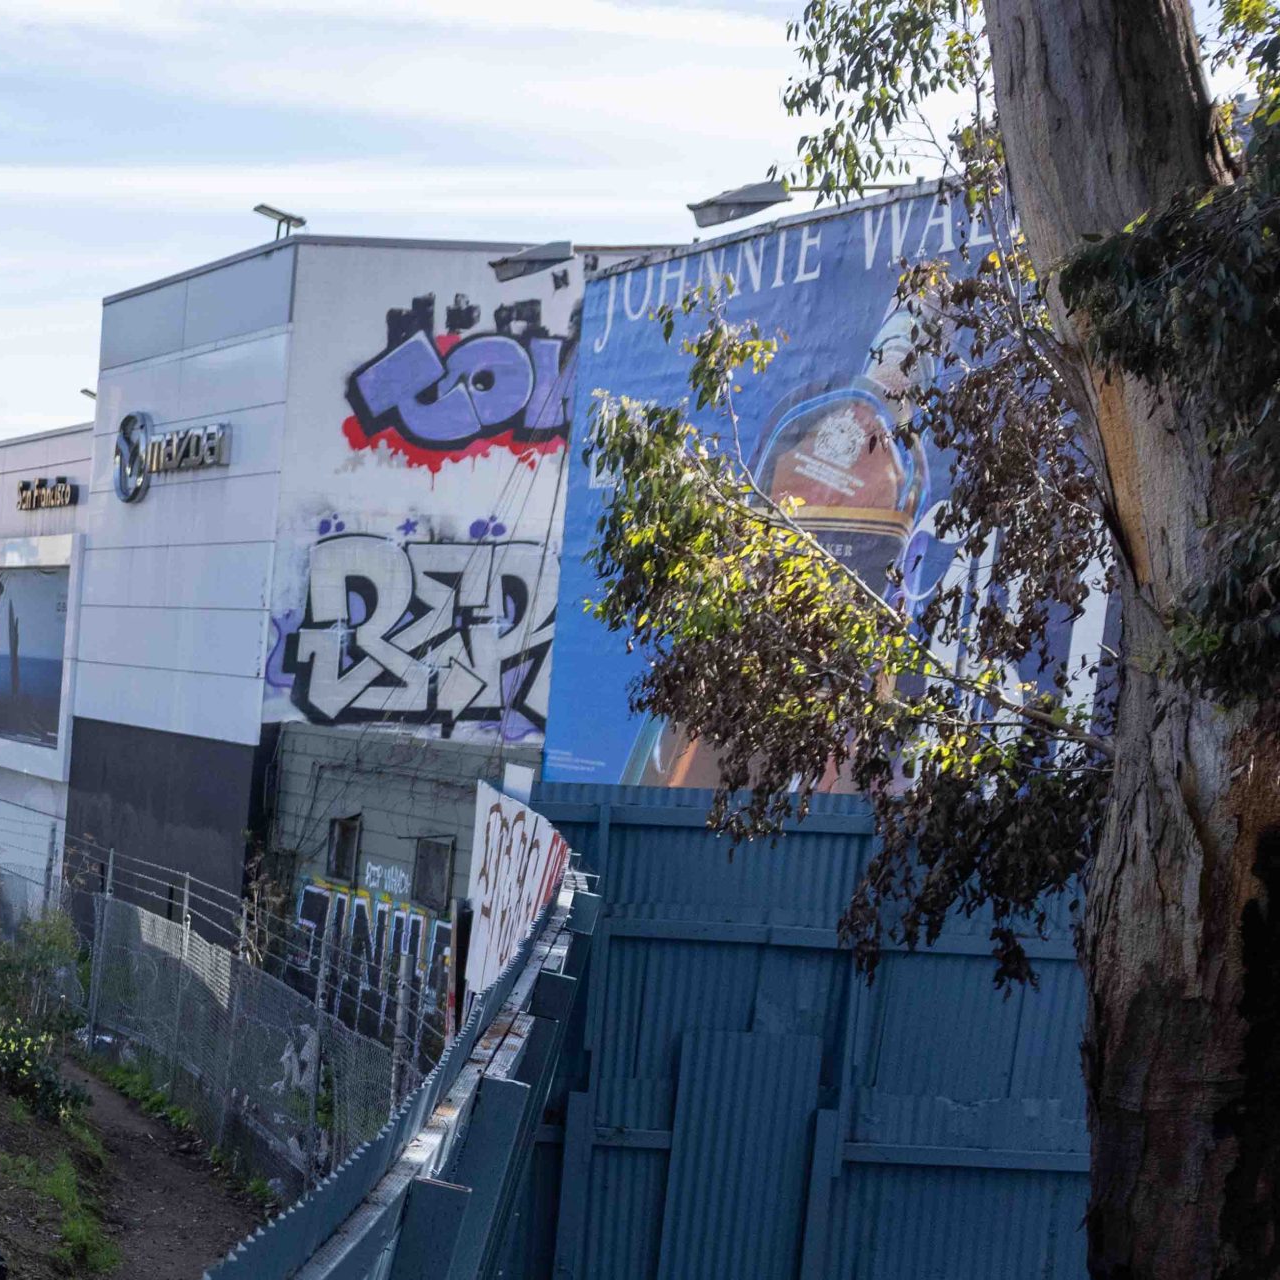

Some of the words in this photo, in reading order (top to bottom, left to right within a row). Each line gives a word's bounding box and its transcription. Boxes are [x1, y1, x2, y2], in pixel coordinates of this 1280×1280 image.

[594, 225, 822, 354] JOHNNIE
[16, 480, 32, 510] San
[34, 477, 73, 508] Francisco
